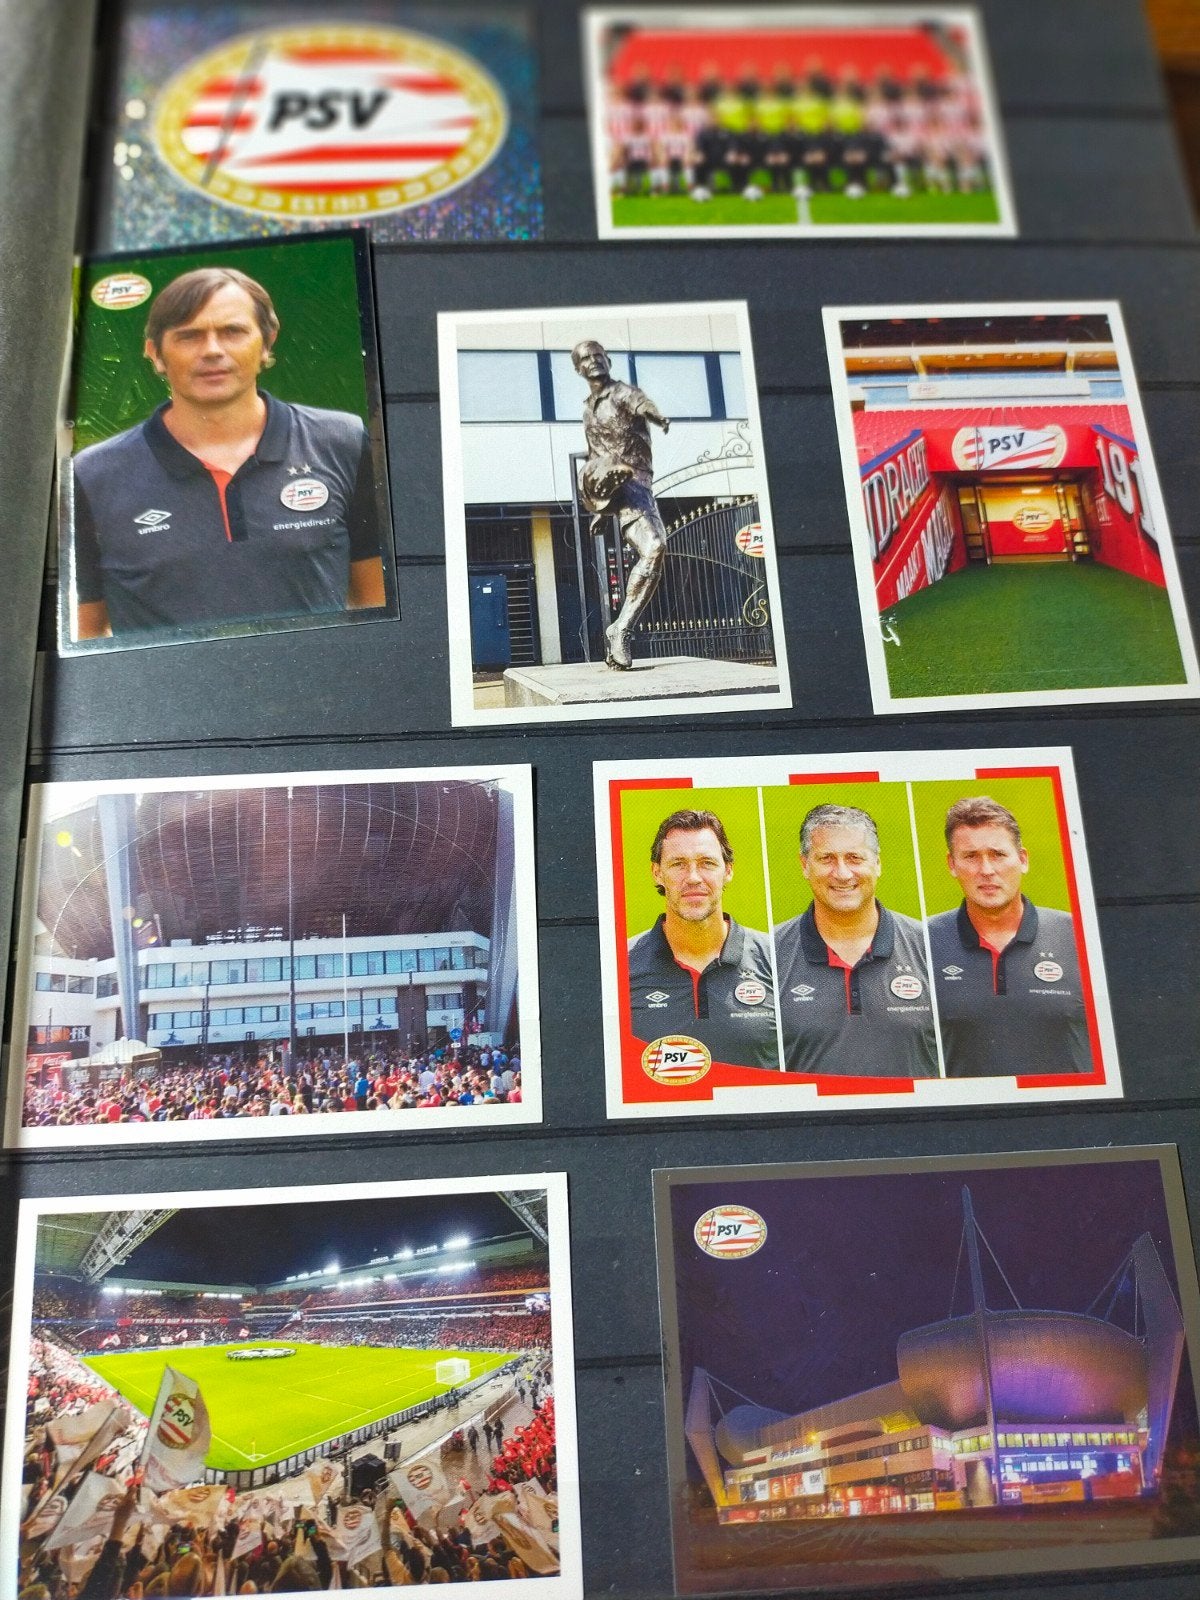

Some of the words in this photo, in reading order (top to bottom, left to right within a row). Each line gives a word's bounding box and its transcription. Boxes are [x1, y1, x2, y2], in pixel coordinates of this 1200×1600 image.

[267, 89, 389, 132] PSV
[111, 286, 132, 294] PSV
[988, 432, 1025, 454] PSV
[138, 523, 170, 535] umbro
[664, 1052, 688, 1063] PSV
[717, 1224, 742, 1236] PSV
[173, 1408, 194, 1426] PSV
